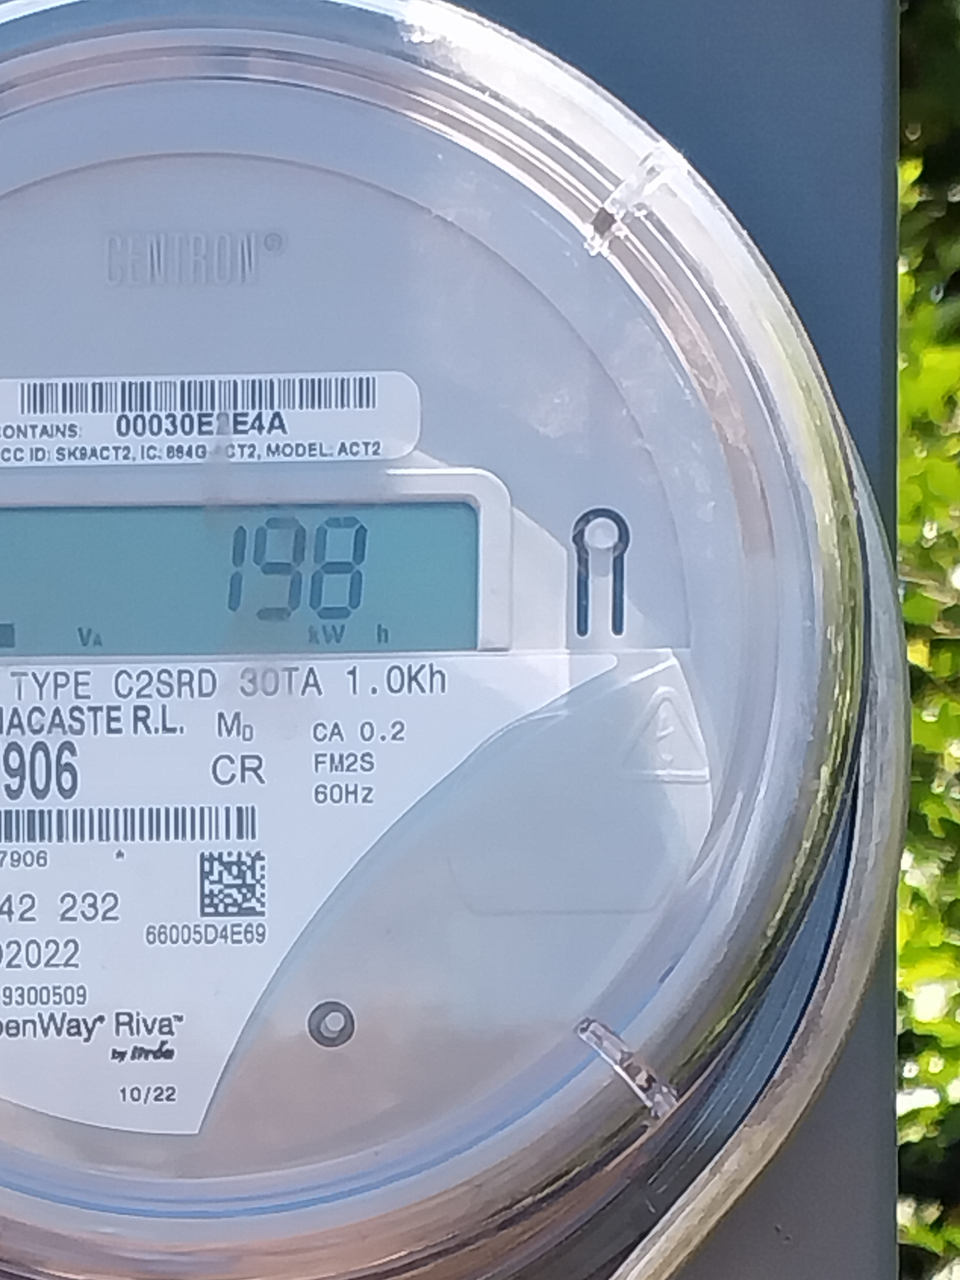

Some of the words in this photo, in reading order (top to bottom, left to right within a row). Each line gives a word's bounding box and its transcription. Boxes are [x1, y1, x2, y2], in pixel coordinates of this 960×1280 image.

[337, 439, 382, 458] ACT2
[227, 516, 369, 621] 198
[10, 669, 92, 701] TYPE
[114, 667, 218, 699] C2SRD
[240, 666, 324, 697] 30TA
[345, 662, 447, 696] 1.0Kh
[132, 702, 185, 736] R.L.
[312, 722, 344, 743] CA
[359, 720, 406, 742] 0.2
[211, 754, 267, 786] CR
[314, 752, 375, 774] FM2S
[314, 783, 375, 805] 60Hz
[58, 891, 120, 922] 232
[145, 922, 267, 945] 66005D4E69
[2, 985, 88, 1007] 9300509
[119, 1086, 177, 1105] 10/22
